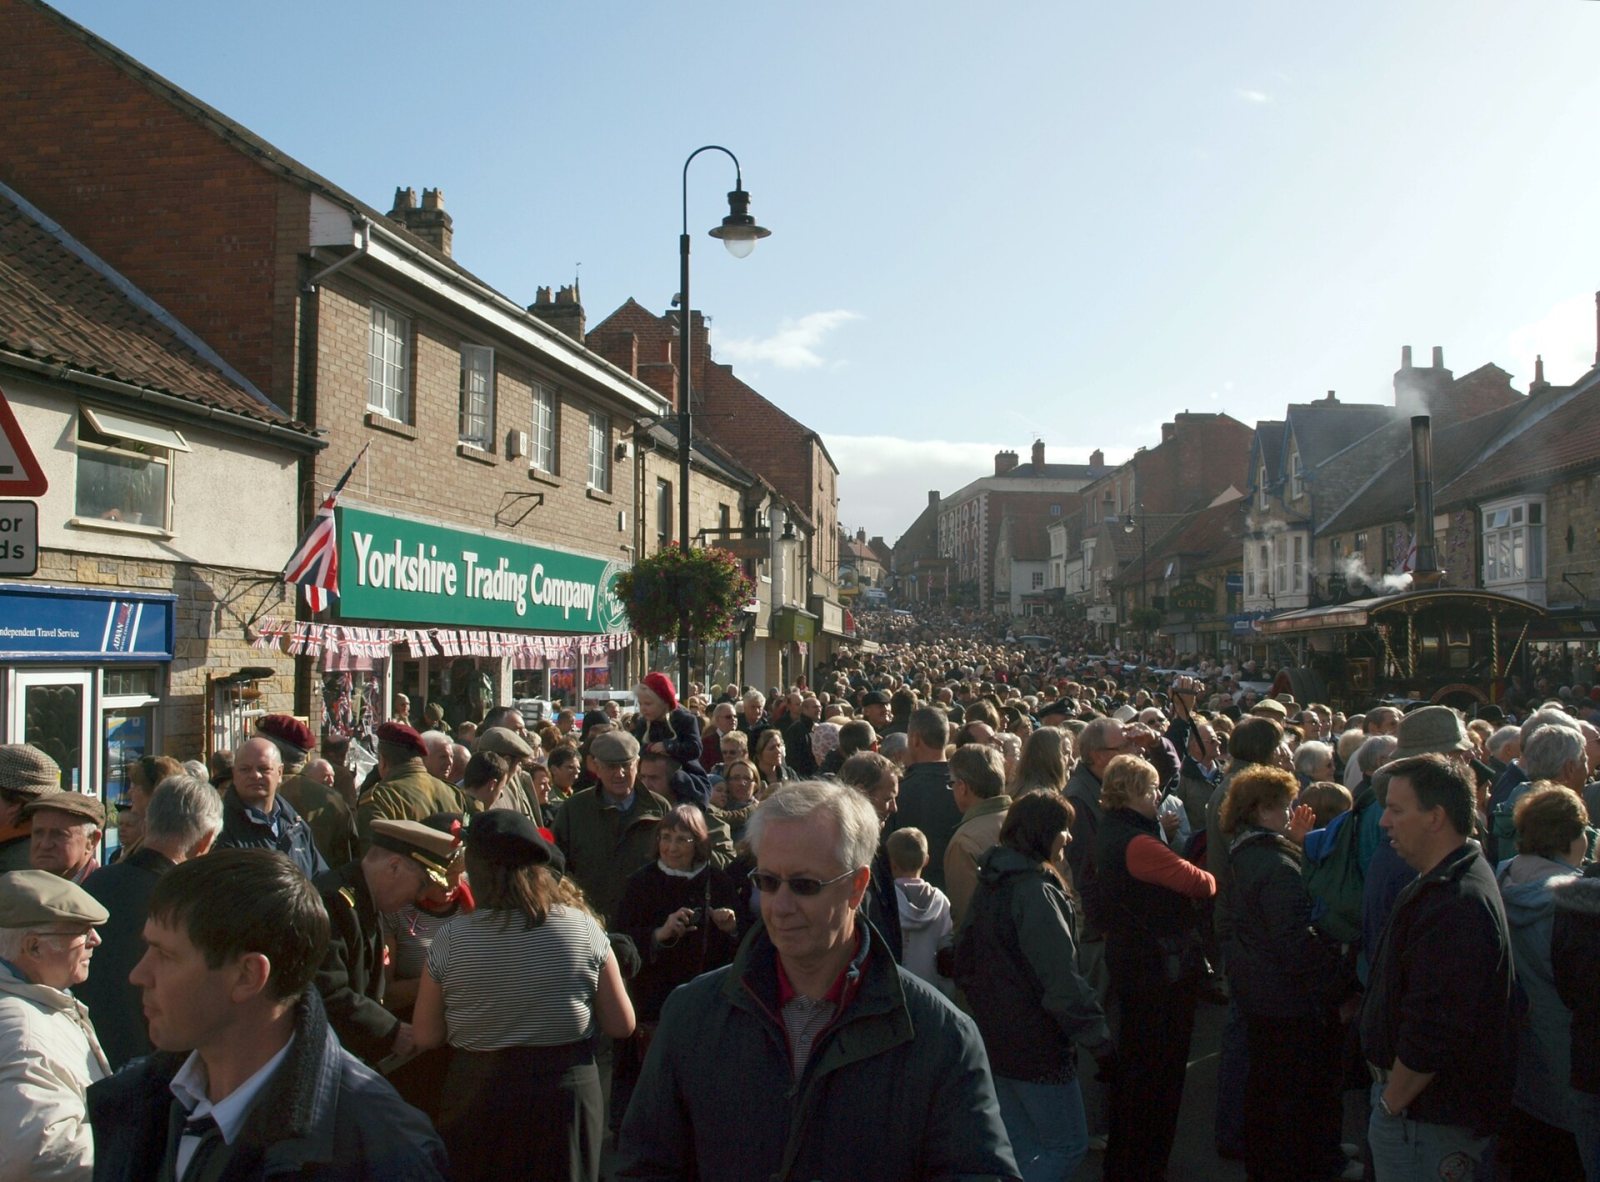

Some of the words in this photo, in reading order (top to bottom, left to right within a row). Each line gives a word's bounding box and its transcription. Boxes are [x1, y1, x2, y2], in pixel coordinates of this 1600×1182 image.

[352, 531, 457, 596] Yorkshire
[462, 551, 528, 616] Trading
[531, 563, 595, 621] Company
[36, 627, 57, 637] Travel
[57, 628, 80, 638] Service
